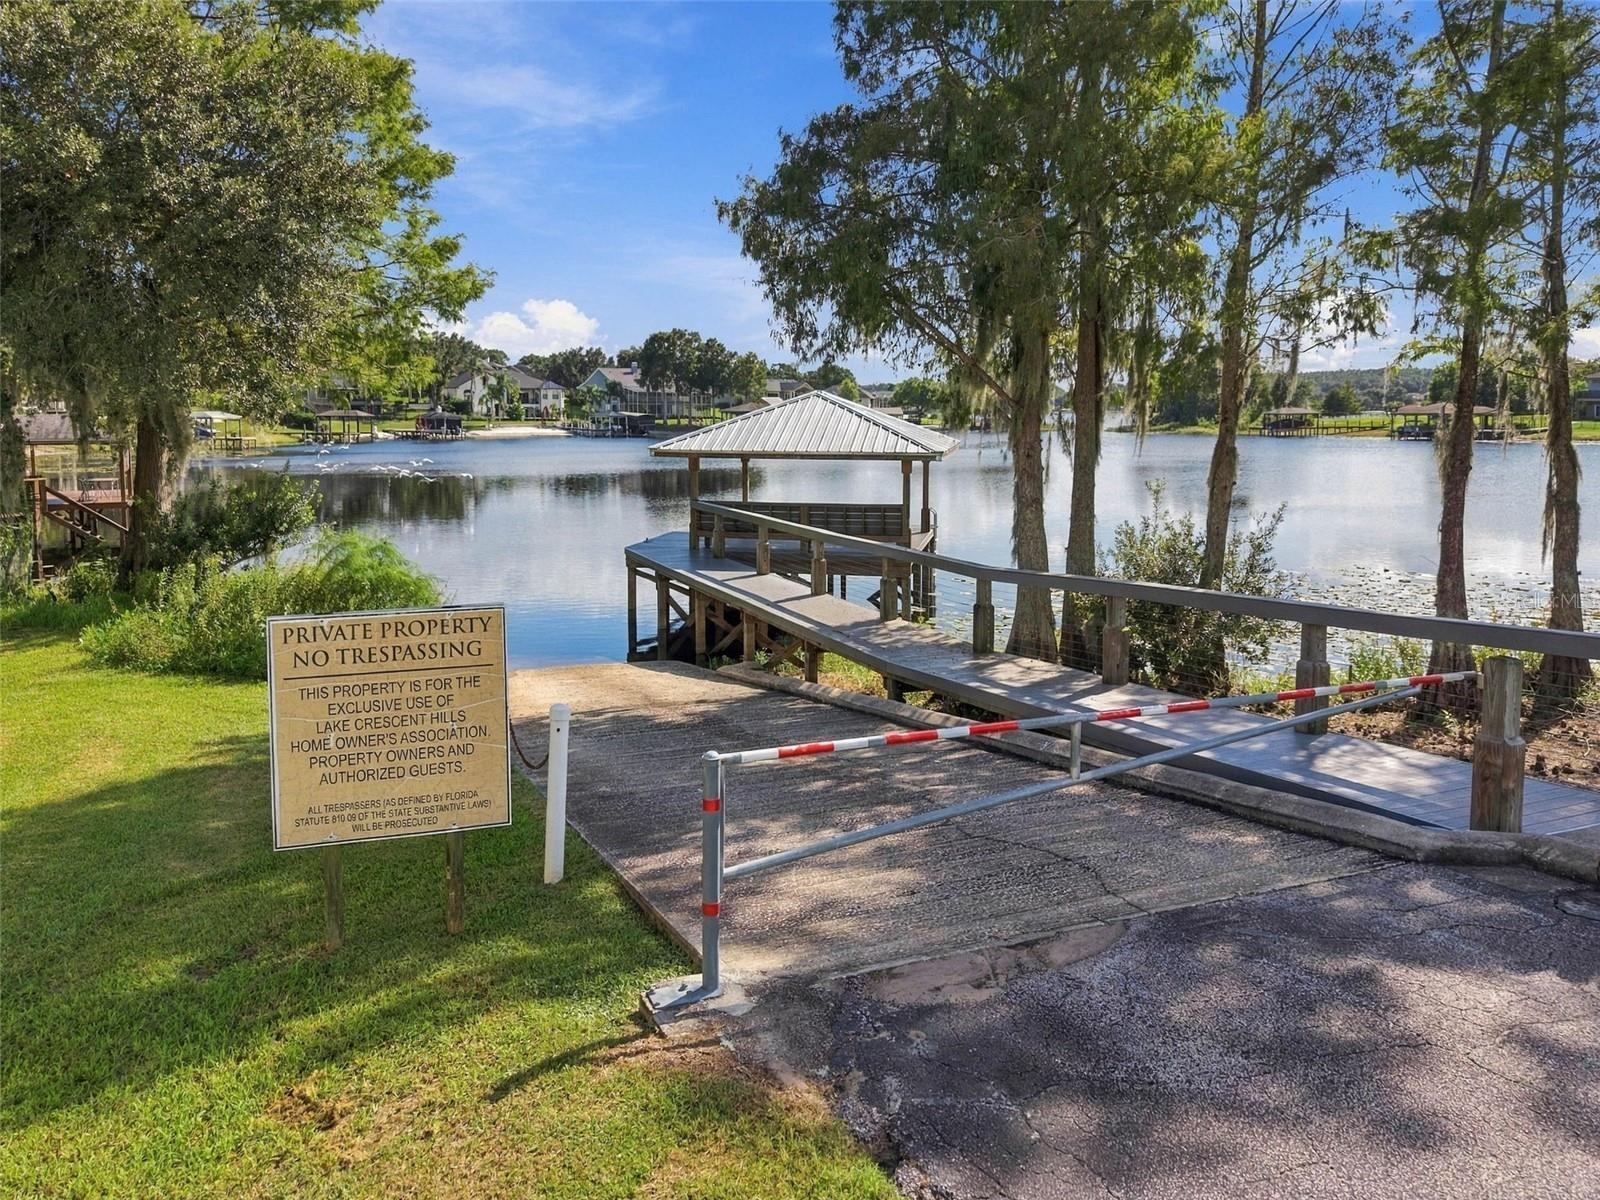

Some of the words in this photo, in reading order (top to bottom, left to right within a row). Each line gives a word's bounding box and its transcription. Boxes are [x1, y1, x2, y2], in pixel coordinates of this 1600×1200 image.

[282, 622, 373, 644] PRIVATE
[381, 616, 492, 639] PROPERTY
[293, 649, 330, 668] NO
[336, 640, 482, 666] TRESPASSING
[298, 686, 329, 701] THIS
[332, 680, 406, 698] PROPERTY
[409, 679, 422, 692] IS
[425, 677, 453, 691] FOR
[456, 675, 481, 689] THE
[327, 697, 402, 716] EXCLUSIVE
[406, 695, 433, 710] USE
[436, 693, 454, 708] OF
[316, 719, 351, 734] LAKE
[354, 713, 427, 731] CRESCENT
[430, 709, 467, 725] HILLS
[290, 738, 331, 753] HOME
[335, 731, 398, 750] OWNER'S
[400, 725, 491, 744] ASSOCIATION.
[309, 751, 383, 769] PROPERTY
[386, 745, 445, 763] OWNERS
[447, 742, 475, 756] AND
[319, 766, 406, 786] AUTHORIZED
[409, 760, 467, 778] GUESTS.
[294, 816, 330, 828] STATUTE
[358, 812, 369, 821] OF
[371, 810, 386, 819] THE
[388, 807, 412, 818] STATE
[414, 801, 466, 815] SUBSTANTIVE
[467, 799, 492, 810] LAWS)
[307, 805, 322, 815] ALL
[324, 799, 382, 814] TRESPASSERS
[383, 797, 396, 809] (AS
[397, 794, 432, 806] DEFINED
[433, 792, 445, 802] BY
[445, 789, 479, 801] FLORIDA
[351, 823, 371, 833] WILL
[372, 821, 383, 831] BE
[384, 815, 439, 830] PROSECUTED
